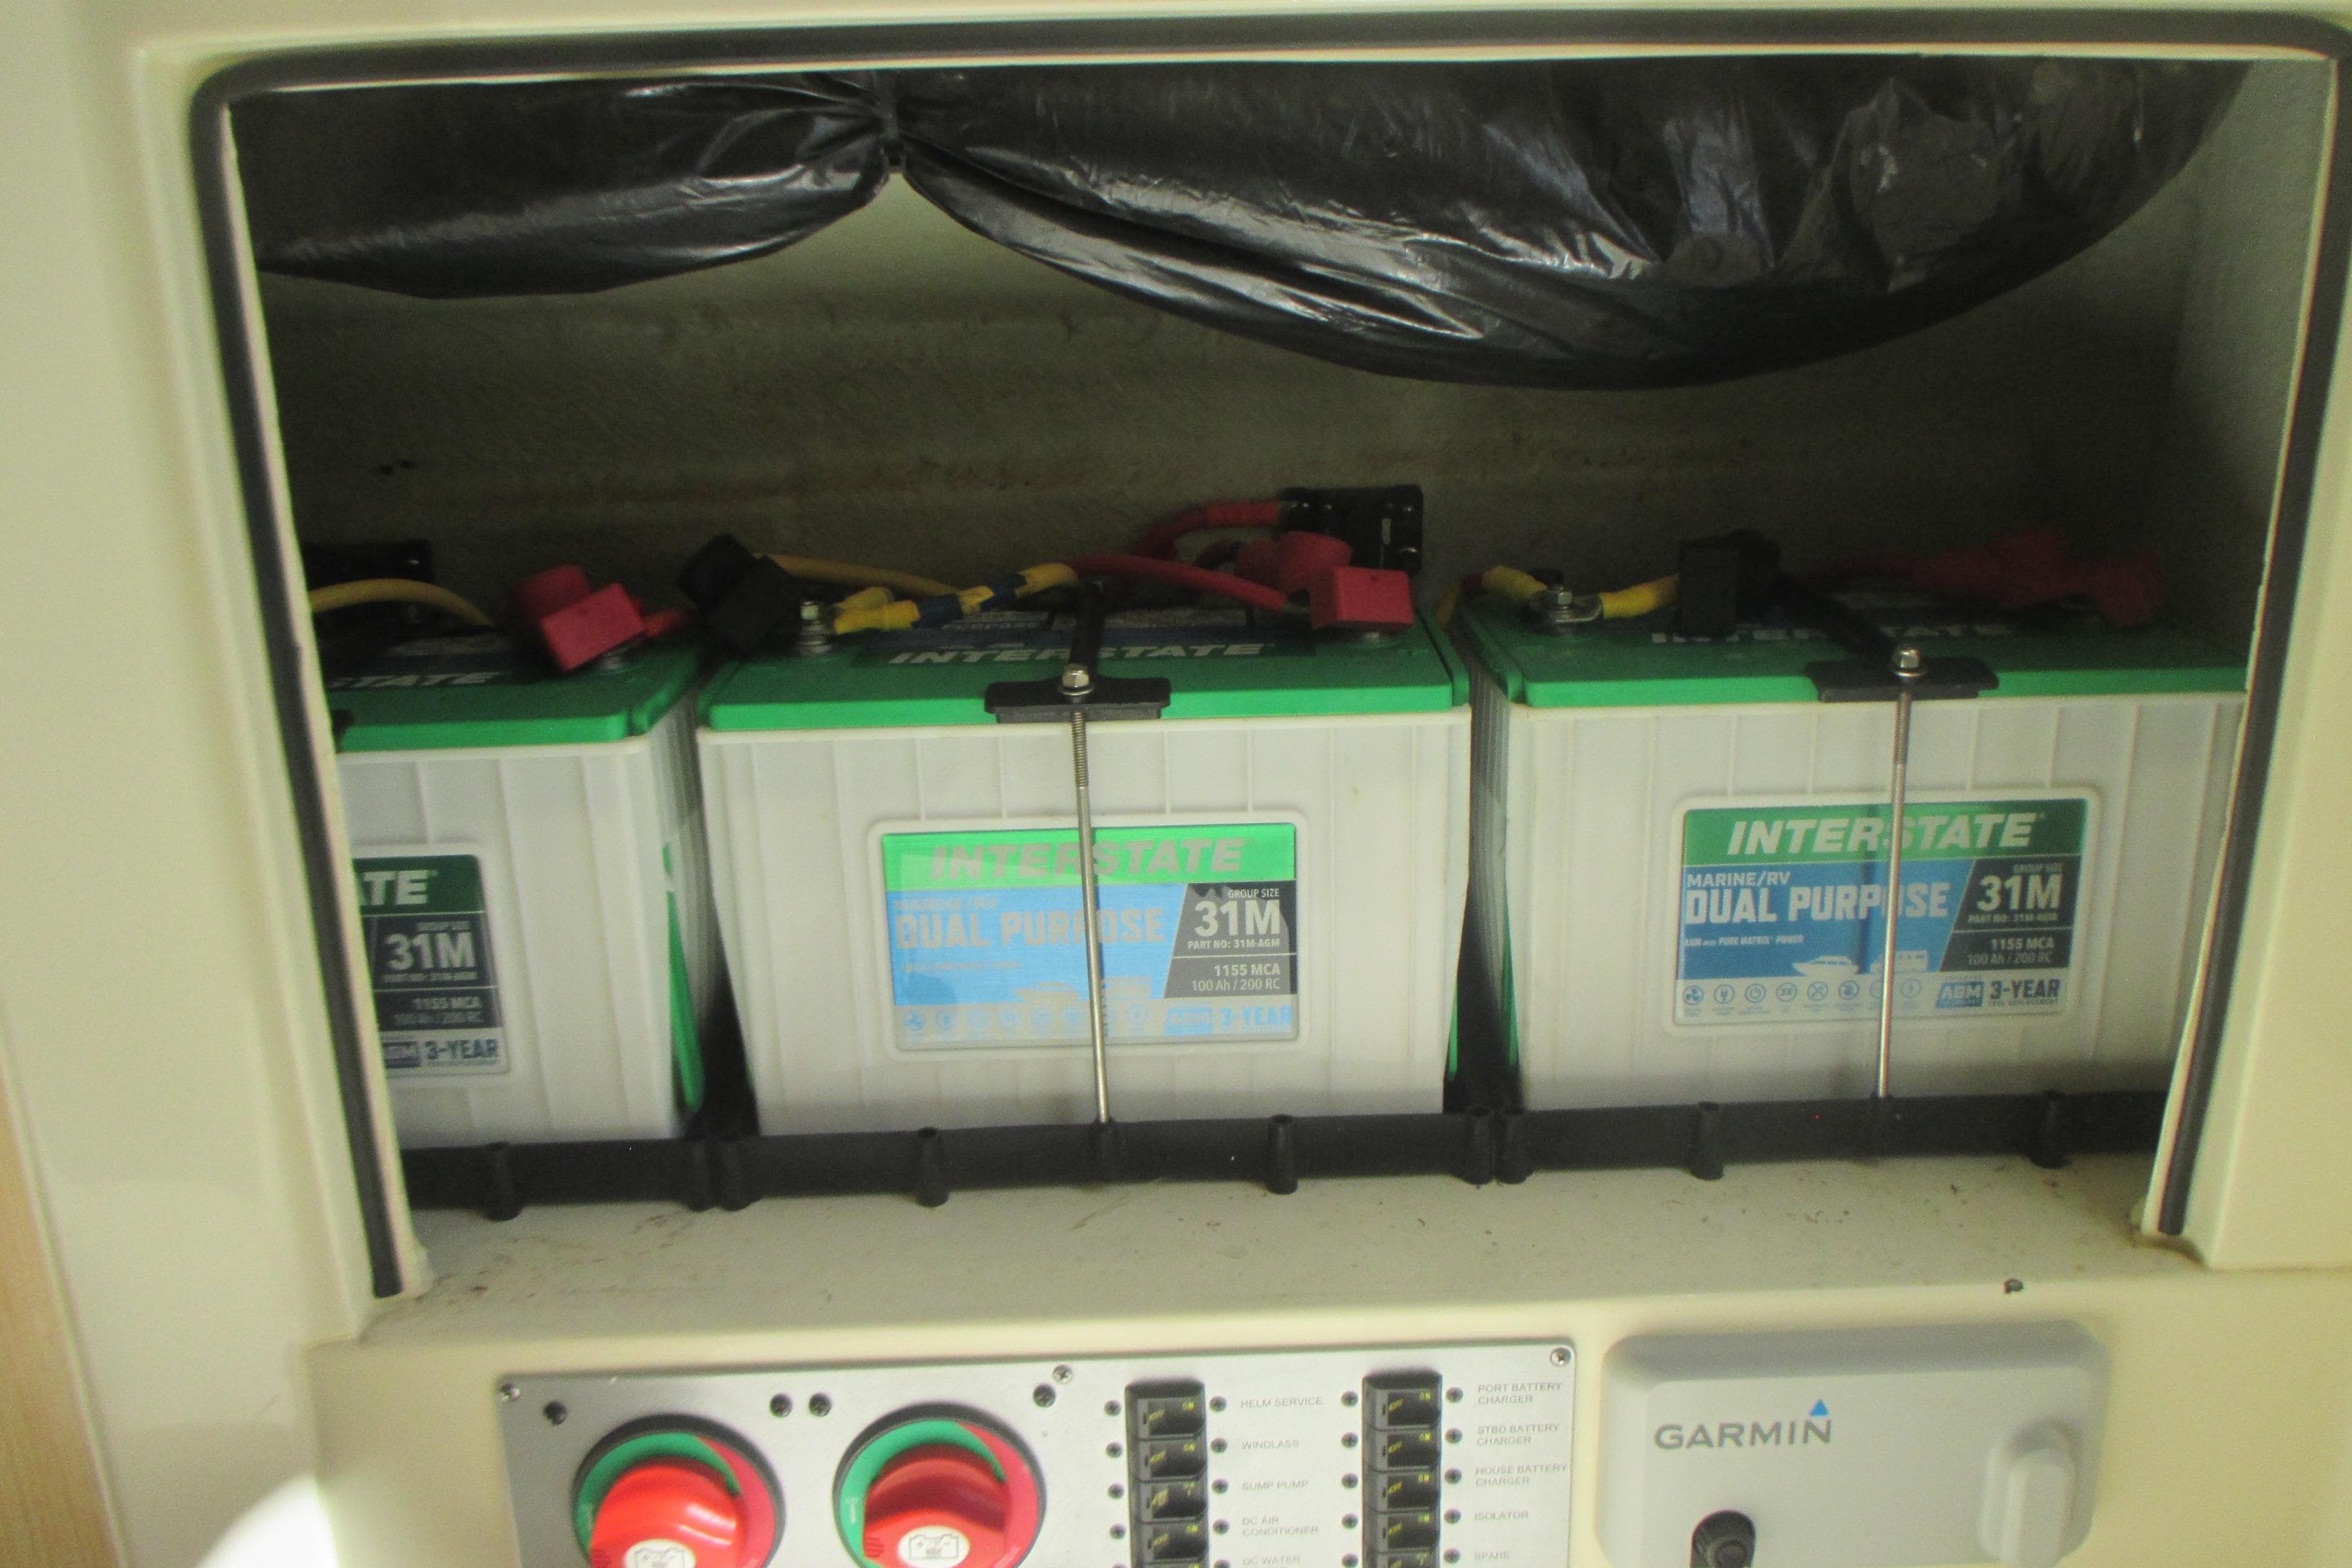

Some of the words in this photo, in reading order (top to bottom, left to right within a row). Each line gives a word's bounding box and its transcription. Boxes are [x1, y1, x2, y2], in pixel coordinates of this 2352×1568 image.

[1727, 812, 2037, 855] INTERSTATE
[930, 837, 1247, 879] INTERSTATE
[1687, 870, 1791, 887] MARINE/RV
[1227, 889, 1259, 899] GROUP
[1261, 888, 1280, 898] SIZE
[1977, 873, 2063, 912] 31M
[1684, 887, 1778, 925] DUAL
[1193, 899, 1281, 938] 31M
[895, 912, 991, 950] DUAL
[1188, 940, 1211, 950] PART
[1213, 939, 1231, 949] NO:
[1233, 938, 1280, 948] 31M-AGM
[2026, 937, 2054, 949] MCA
[385, 932, 476, 971] 31M
[1214, 964, 1247, 976] 1155
[1250, 963, 1280, 976] MCA
[1192, 980, 1214, 992] 100
[1216, 979, 1231, 991] Ah
[1240, 979, 1261, 990] 200
[1265, 978, 1280, 990] RC
[1990, 977, 2061, 999] 3-YEAR
[1219, 1004, 1292, 1027] 3-YEAR
[1478, 1384, 1510, 1393] PORT
[1513, 1382, 1563, 1391] BATTERY
[1240, 1399, 1270, 1408] HELM
[1274, 1396, 1323, 1407] SERVICE
[1478, 1394, 1533, 1404] CHARGER
[1477, 1425, 1507, 1435] STBD
[1510, 1423, 1560, 1433] BATTERY
[1654, 1419, 1832, 1451] GARMIN
[1242, 1439, 1300, 1450] WINDLASS
[1477, 1435, 1532, 1446] CHARGER
[1476, 1466, 1514, 1475] HOUSE
[1517, 1464, 1569, 1473] BATTERY
[1242, 1482, 1274, 1491] SUMP
[1277, 1479, 1309, 1489] PUMP
[1476, 1476, 1531, 1487] CHARGER
[1242, 1517, 1259, 1526] DC
[1261, 1516, 1279, 1525] AIR
[1475, 1510, 1529, 1520] ISOLATOR
[1242, 1525, 1320, 1537] CONDITIONER
[1262, 1555, 1301, 1565] WATER
[1474, 1551, 1510, 1560] SPARE
